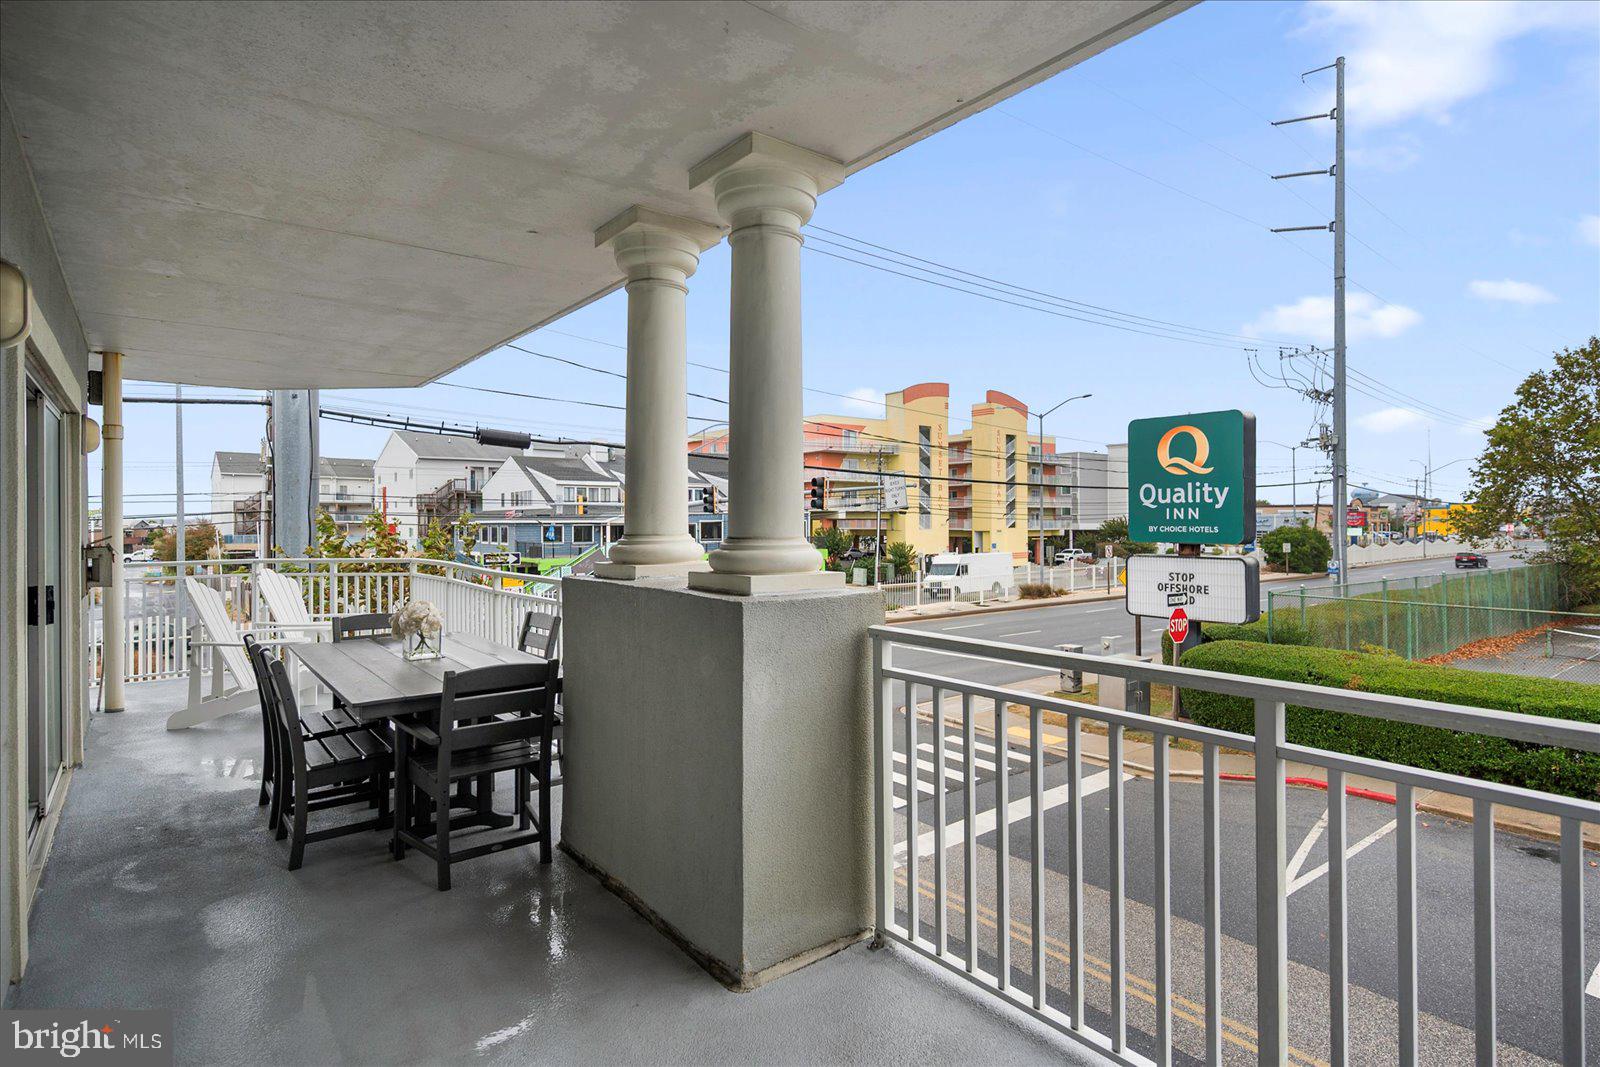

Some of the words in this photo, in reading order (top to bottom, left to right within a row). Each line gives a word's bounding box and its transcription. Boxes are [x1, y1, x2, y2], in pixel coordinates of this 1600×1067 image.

[1157, 425, 1214, 475] Q
[1139, 481, 1229, 509] Quality
[1166, 507, 1199, 520] INN
[1148, 525, 1158, 533] BY
[1159, 525, 1187, 533] CHOICE
[1188, 525, 1219, 533] HOTELS
[1168, 572, 1195, 582] STOP
[1157, 582, 1210, 595] OFFSHORE
[1170, 618, 1187, 633] STOP
